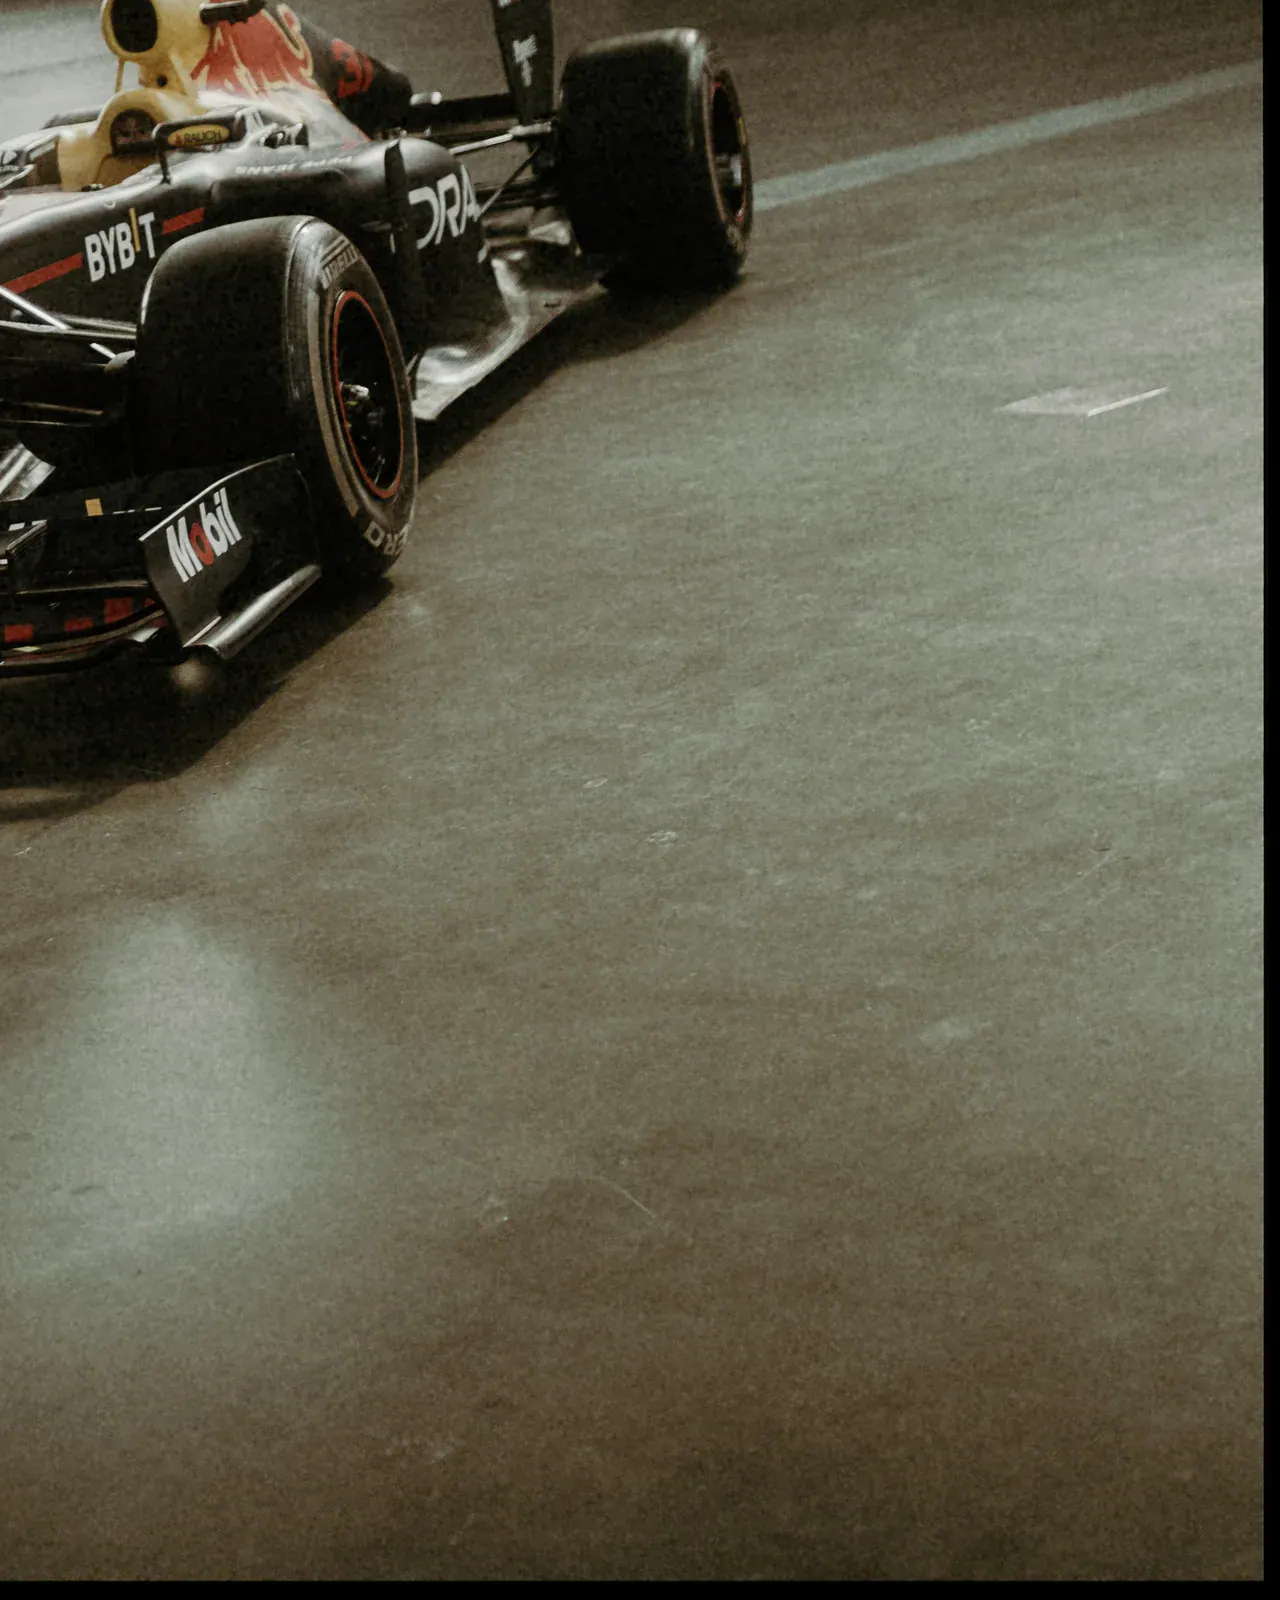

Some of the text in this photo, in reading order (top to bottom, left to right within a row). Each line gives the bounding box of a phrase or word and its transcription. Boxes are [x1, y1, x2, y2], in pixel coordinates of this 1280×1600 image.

[183, 130, 222, 146] RAUCH
[84, 207, 156, 283] BYBIT
[166, 487, 242, 583] Mobil
